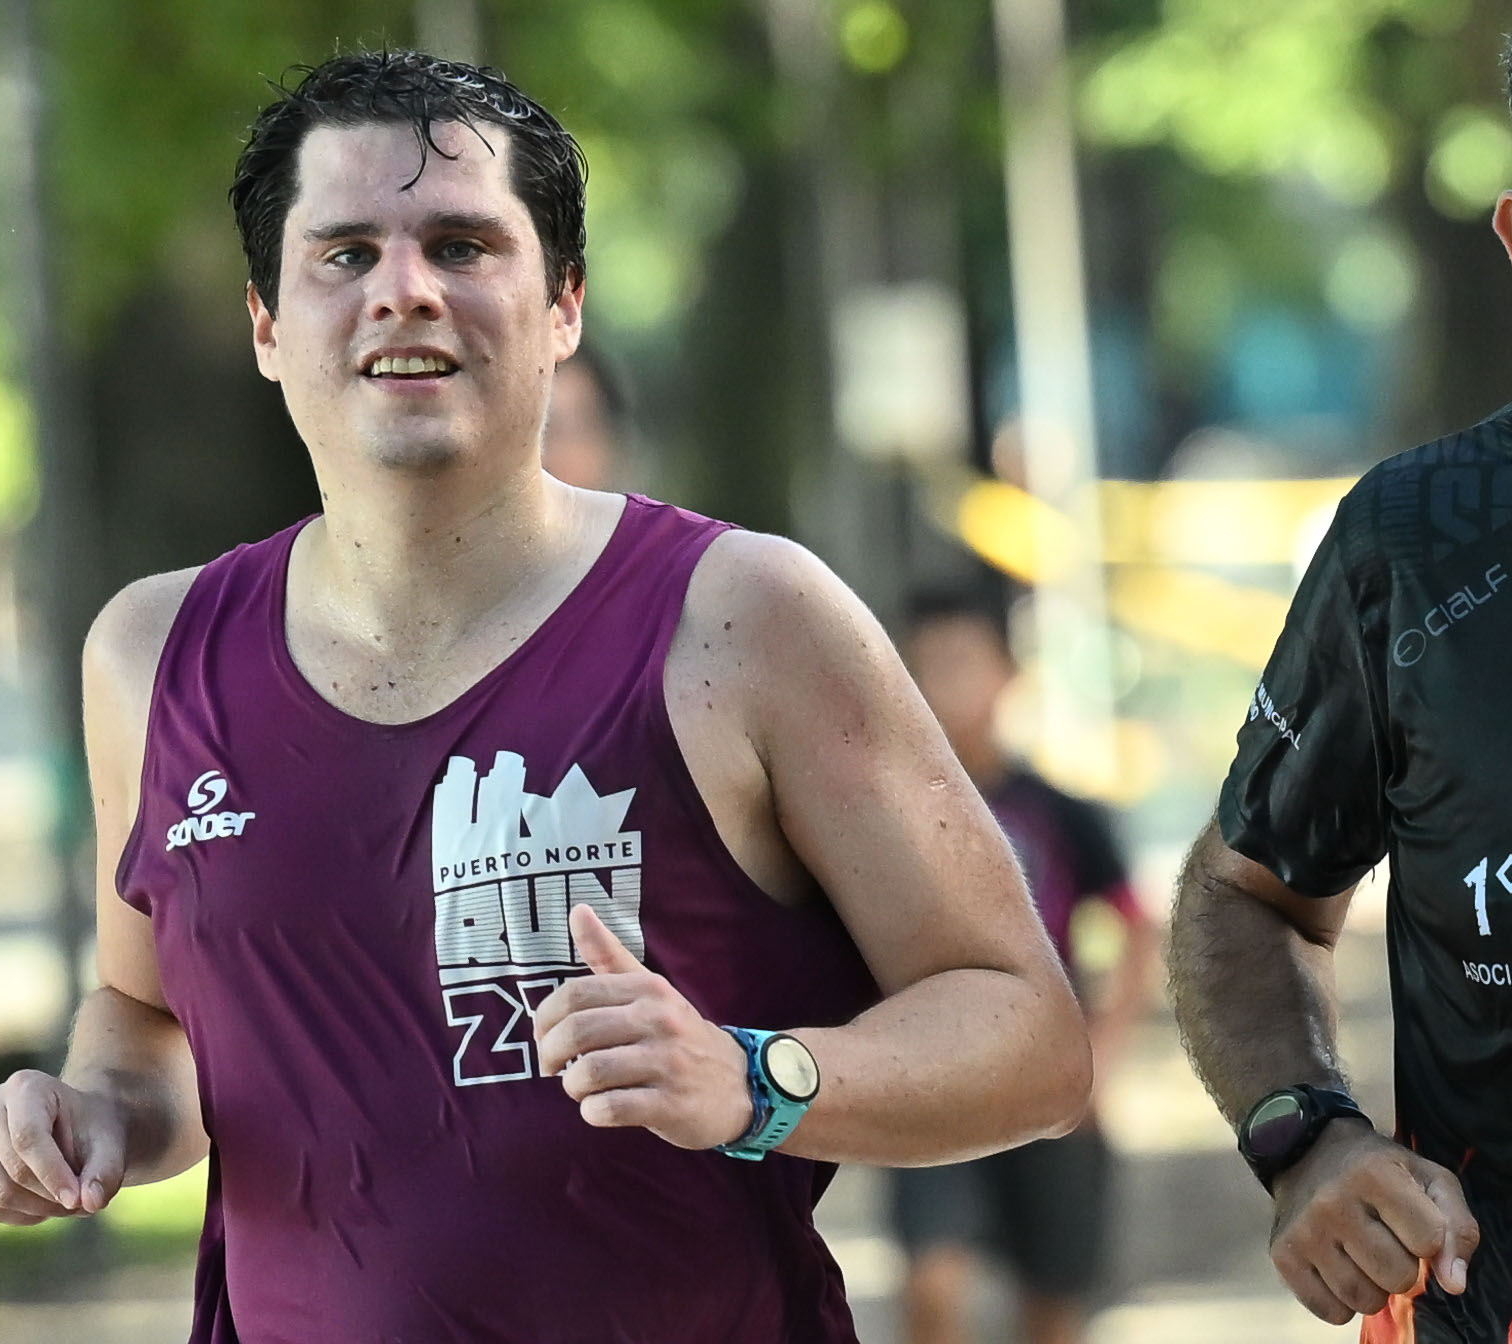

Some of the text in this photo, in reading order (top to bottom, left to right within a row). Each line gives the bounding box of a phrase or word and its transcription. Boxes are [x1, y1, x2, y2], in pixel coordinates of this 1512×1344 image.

[439, 840, 633, 883] PUERTO NORTE
[434, 867, 645, 967] RUN
